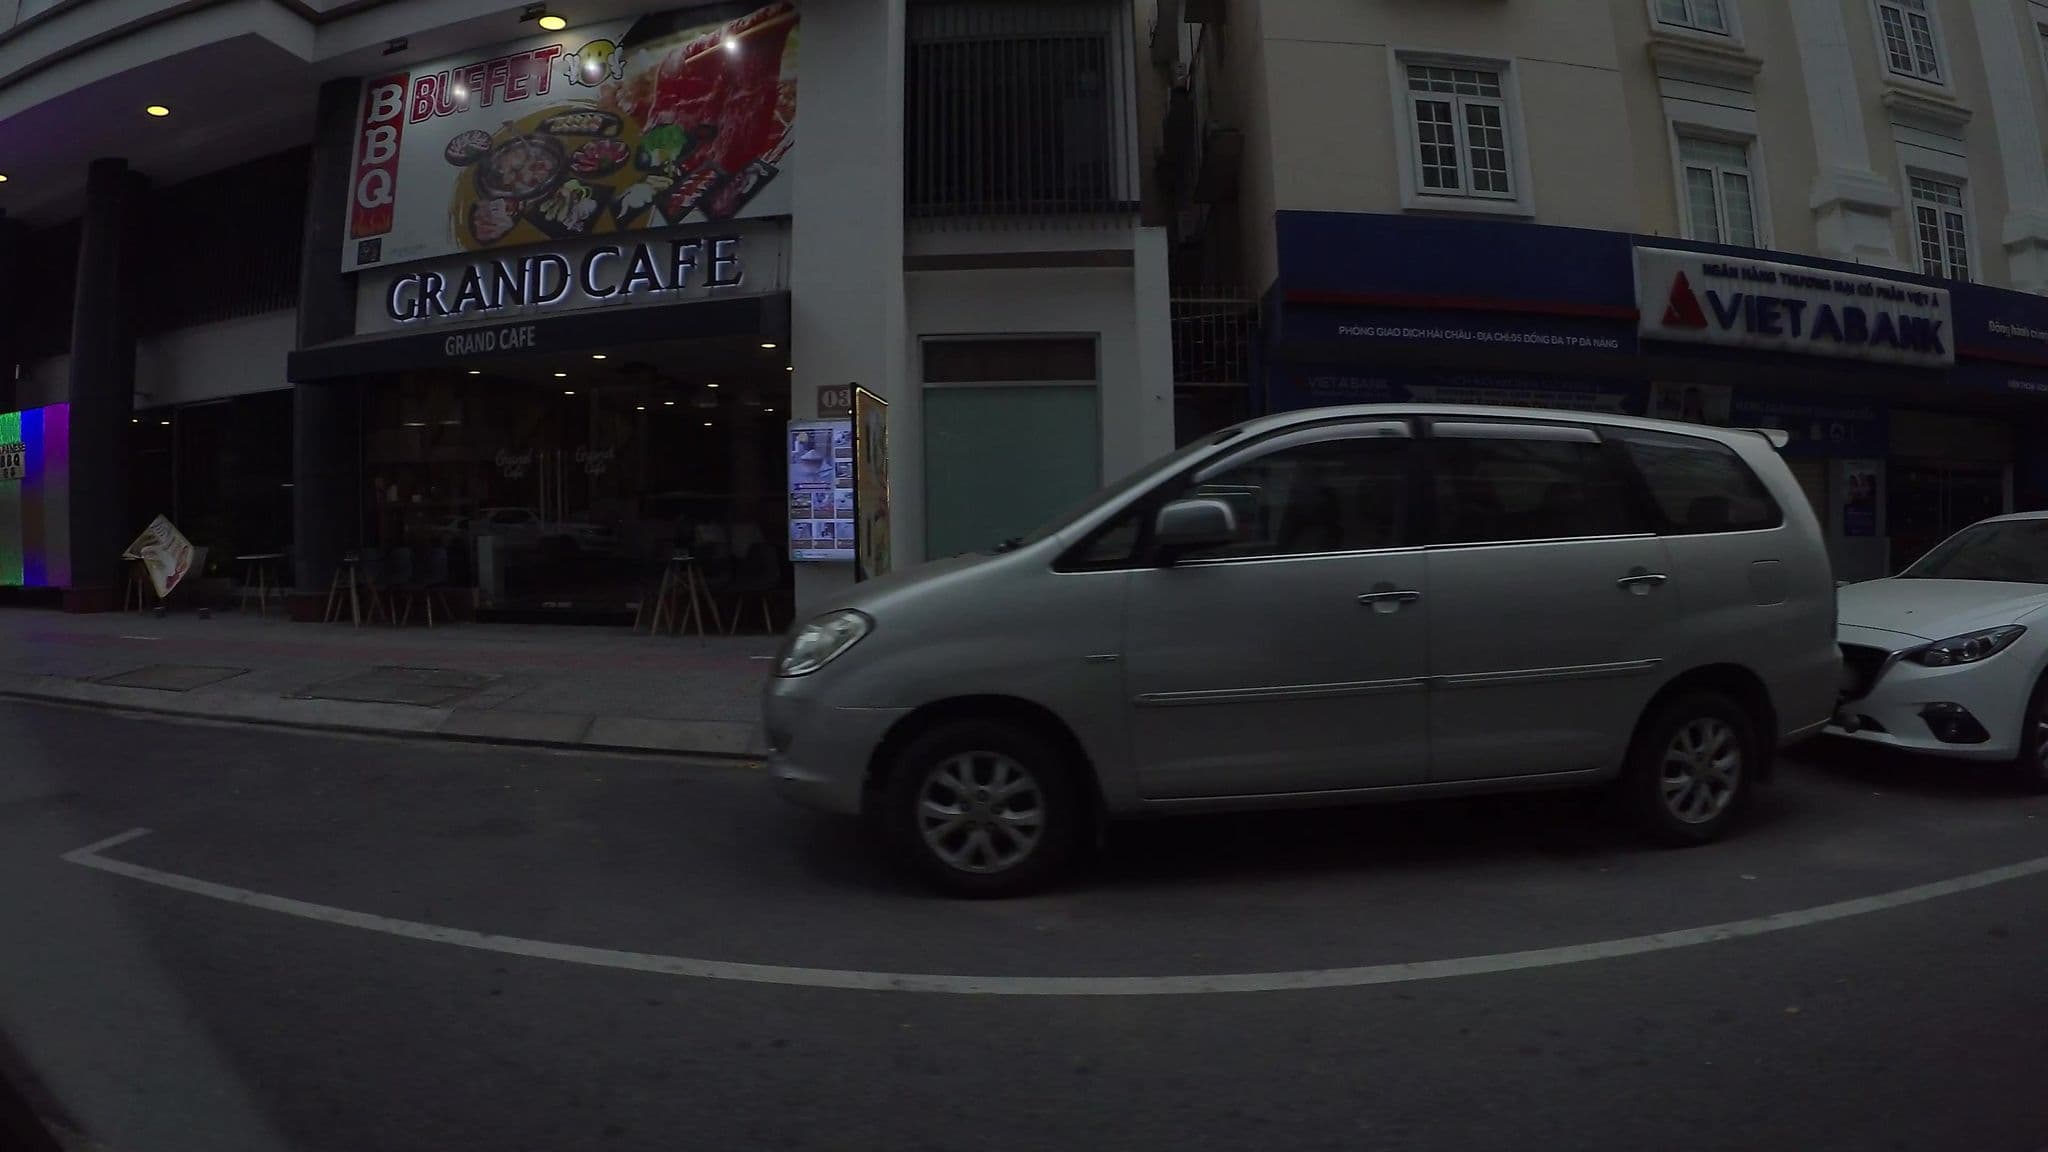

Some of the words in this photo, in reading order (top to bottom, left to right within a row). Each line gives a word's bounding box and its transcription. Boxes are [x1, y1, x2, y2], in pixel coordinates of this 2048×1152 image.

[409, 44, 562, 124] BUFFET
[357, 83, 403, 209] BBQ
[389, 253, 572, 322] GRAND
[580, 235, 743, 299] CAFE
[445, 331, 496, 356] GRAND
[499, 325, 536, 350] CAFE
[1376, 327, 1401, 337] GIAO
